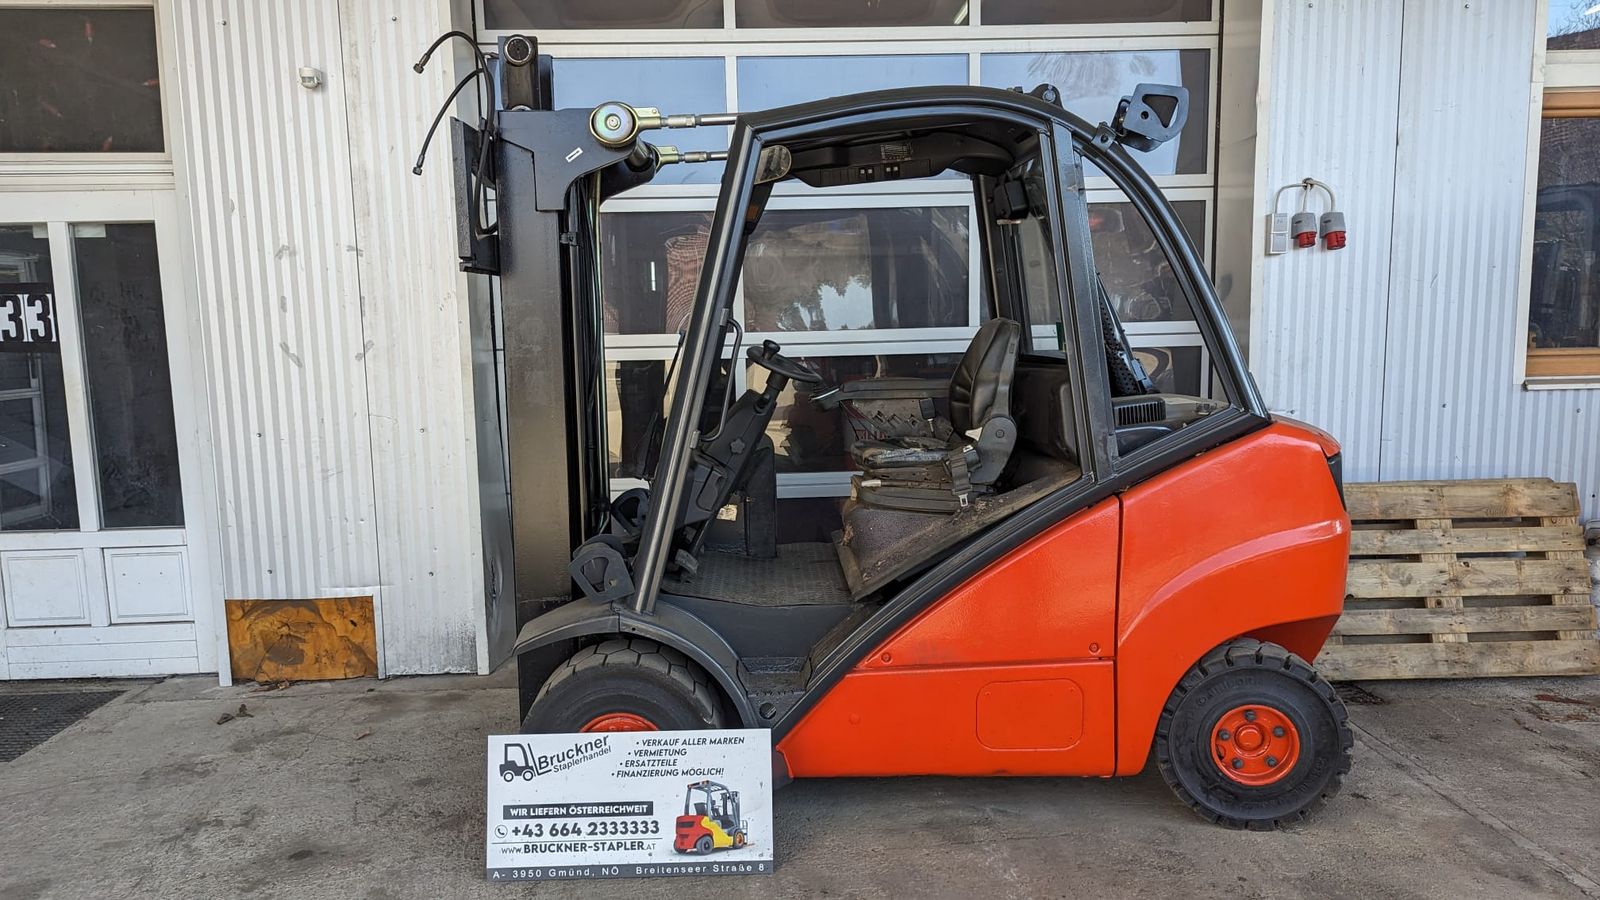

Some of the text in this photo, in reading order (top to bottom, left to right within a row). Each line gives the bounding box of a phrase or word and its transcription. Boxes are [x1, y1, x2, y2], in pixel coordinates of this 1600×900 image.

[641, 736, 745, 747] VERKAUF ALLER MARKEN
[538, 735, 609, 771] Bruckner
[633, 748, 687, 757] VERMIETUNG
[553, 745, 612, 773] Staplerhandel
[625, 759, 678, 768] ERSATZTEILE
[616, 767, 725, 778] FINANZIERUNG MÖGLICH!
[510, 804, 648, 816] WIR LIEFERN ÖSTERREICHWEIT
[512, 820, 660, 838] +43 664 2333333
[512, 869, 542, 878] 3950
[548, 868, 595, 878] Gmünd,
[602, 866, 619, 876] NÖ
[635, 865, 707, 875] Breitenseer
[712, 863, 753, 874] Straße
[758, 863, 766, 872] 8
